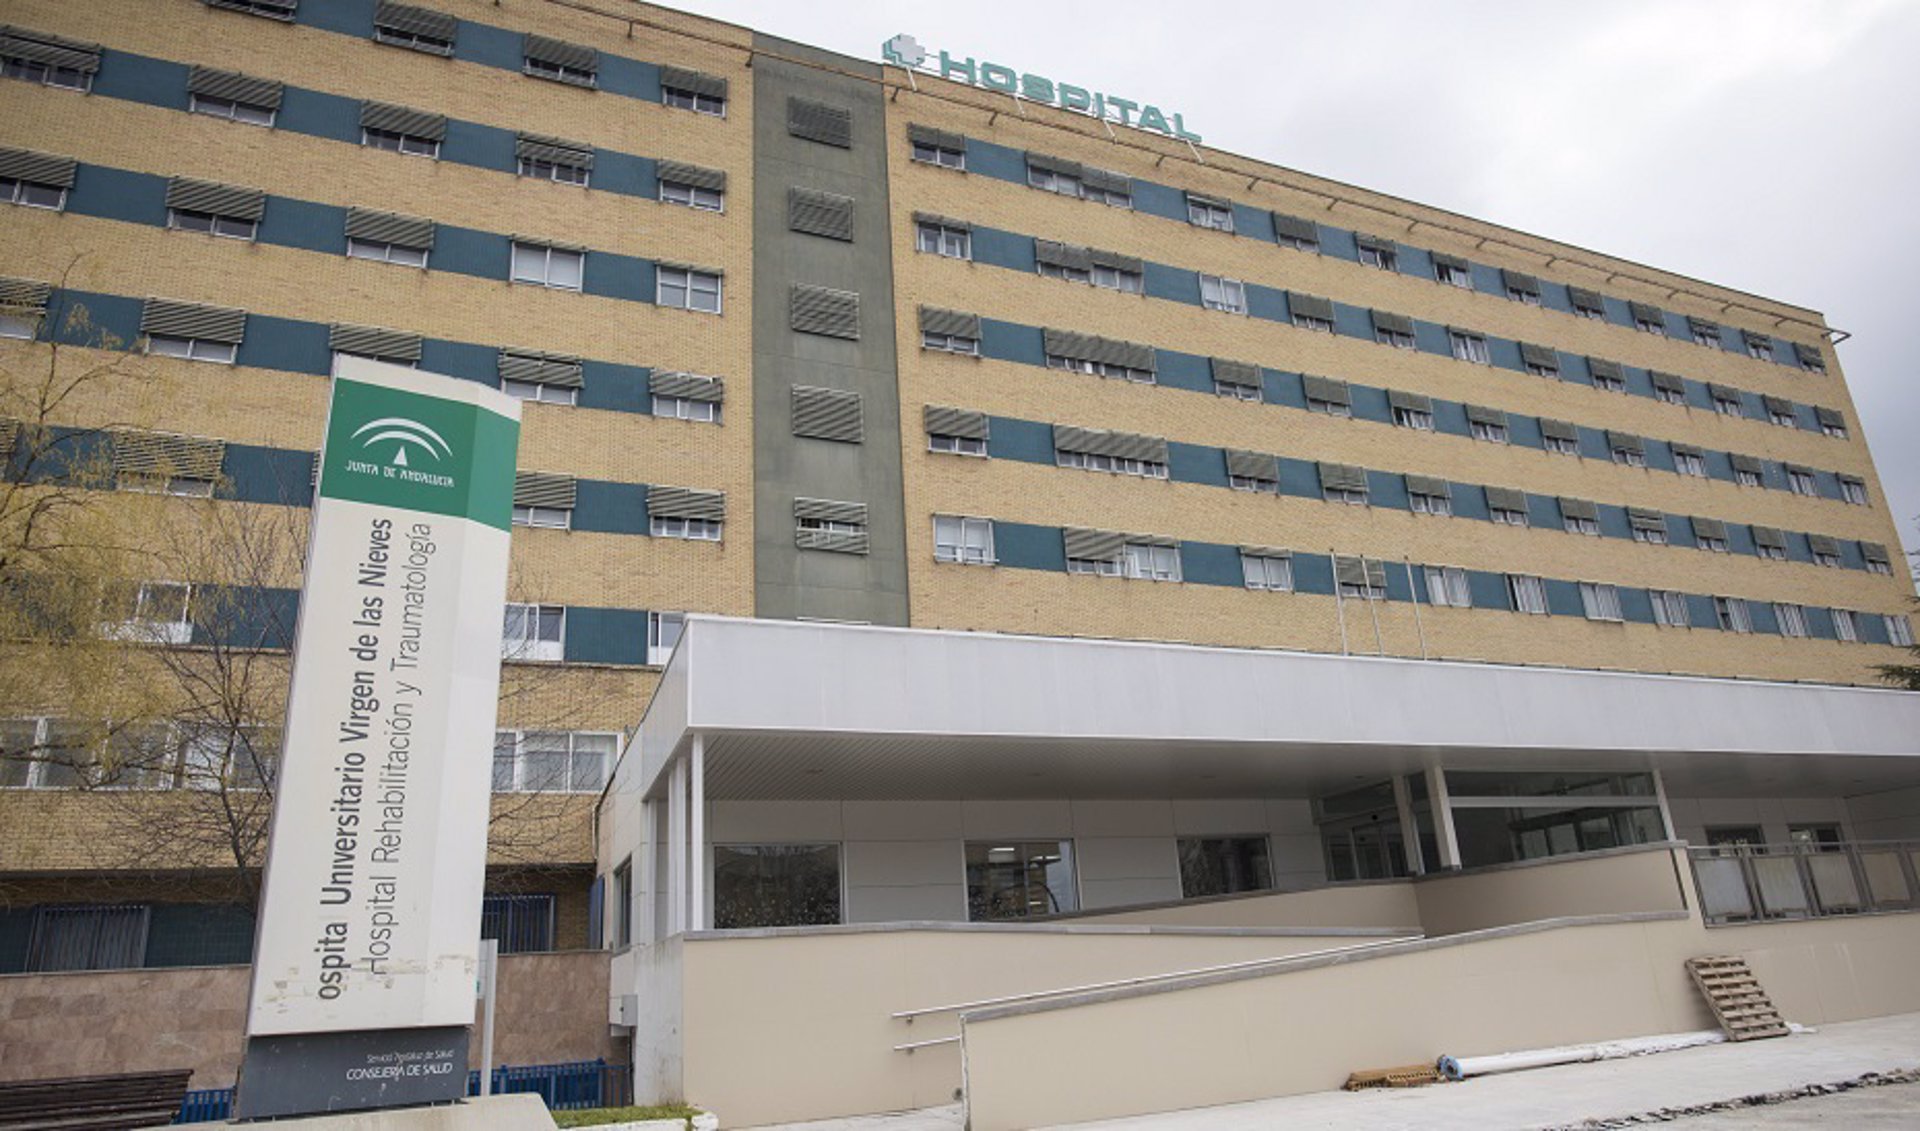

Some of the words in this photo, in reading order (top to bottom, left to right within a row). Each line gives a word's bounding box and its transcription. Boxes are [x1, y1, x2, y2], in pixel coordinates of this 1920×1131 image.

[939, 50, 1202, 142] HOSPITAL
[345, 460, 379, 475] JUNTA
[383, 466, 396, 478] DE
[358, 518, 393, 587] Nieves
[353, 596, 383, 627] las
[390, 522, 436, 671] Traumatología
[349, 634, 379, 661] de
[339, 672, 379, 743] Virgen
[396, 680, 422, 696] y
[371, 702, 413, 863] Rehabilitación
[319, 752, 366, 905] Universitario
[361, 876, 399, 975] Hospital
[406, 1064, 420, 1076] DE
